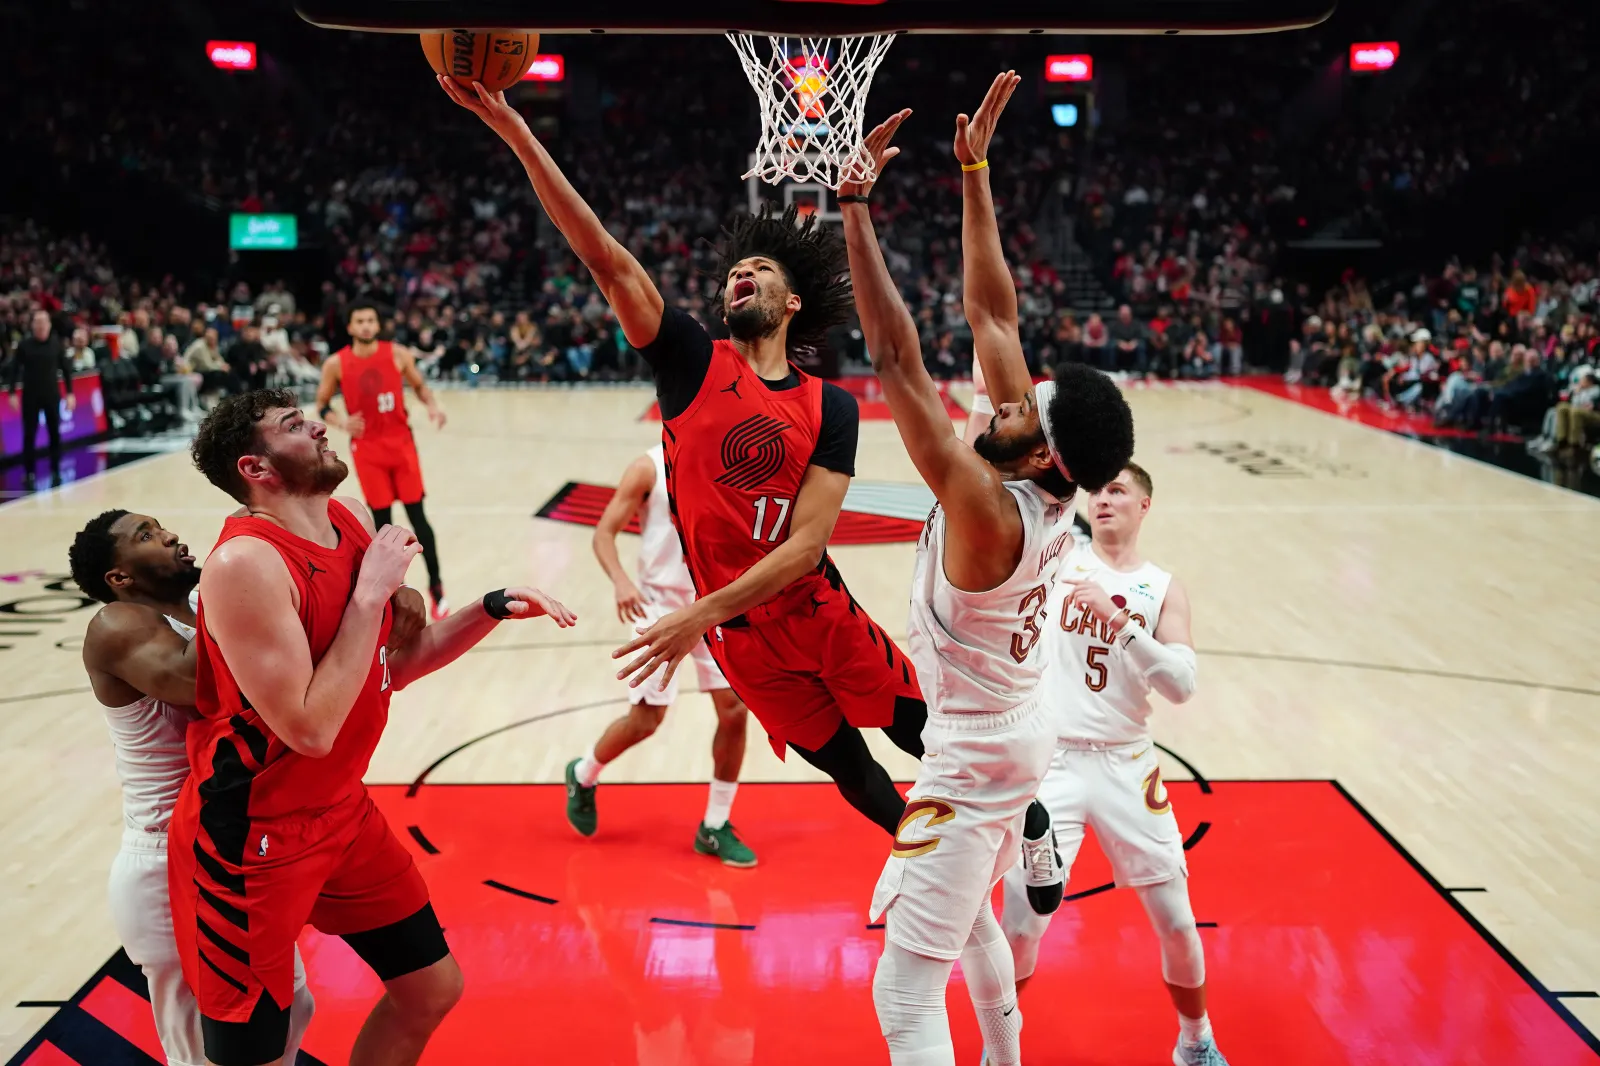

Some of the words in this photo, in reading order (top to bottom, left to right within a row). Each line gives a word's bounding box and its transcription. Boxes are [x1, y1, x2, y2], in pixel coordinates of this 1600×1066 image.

[752, 495, 791, 542] 17
[379, 644, 392, 693] 2
[1085, 645, 1110, 693] 5
